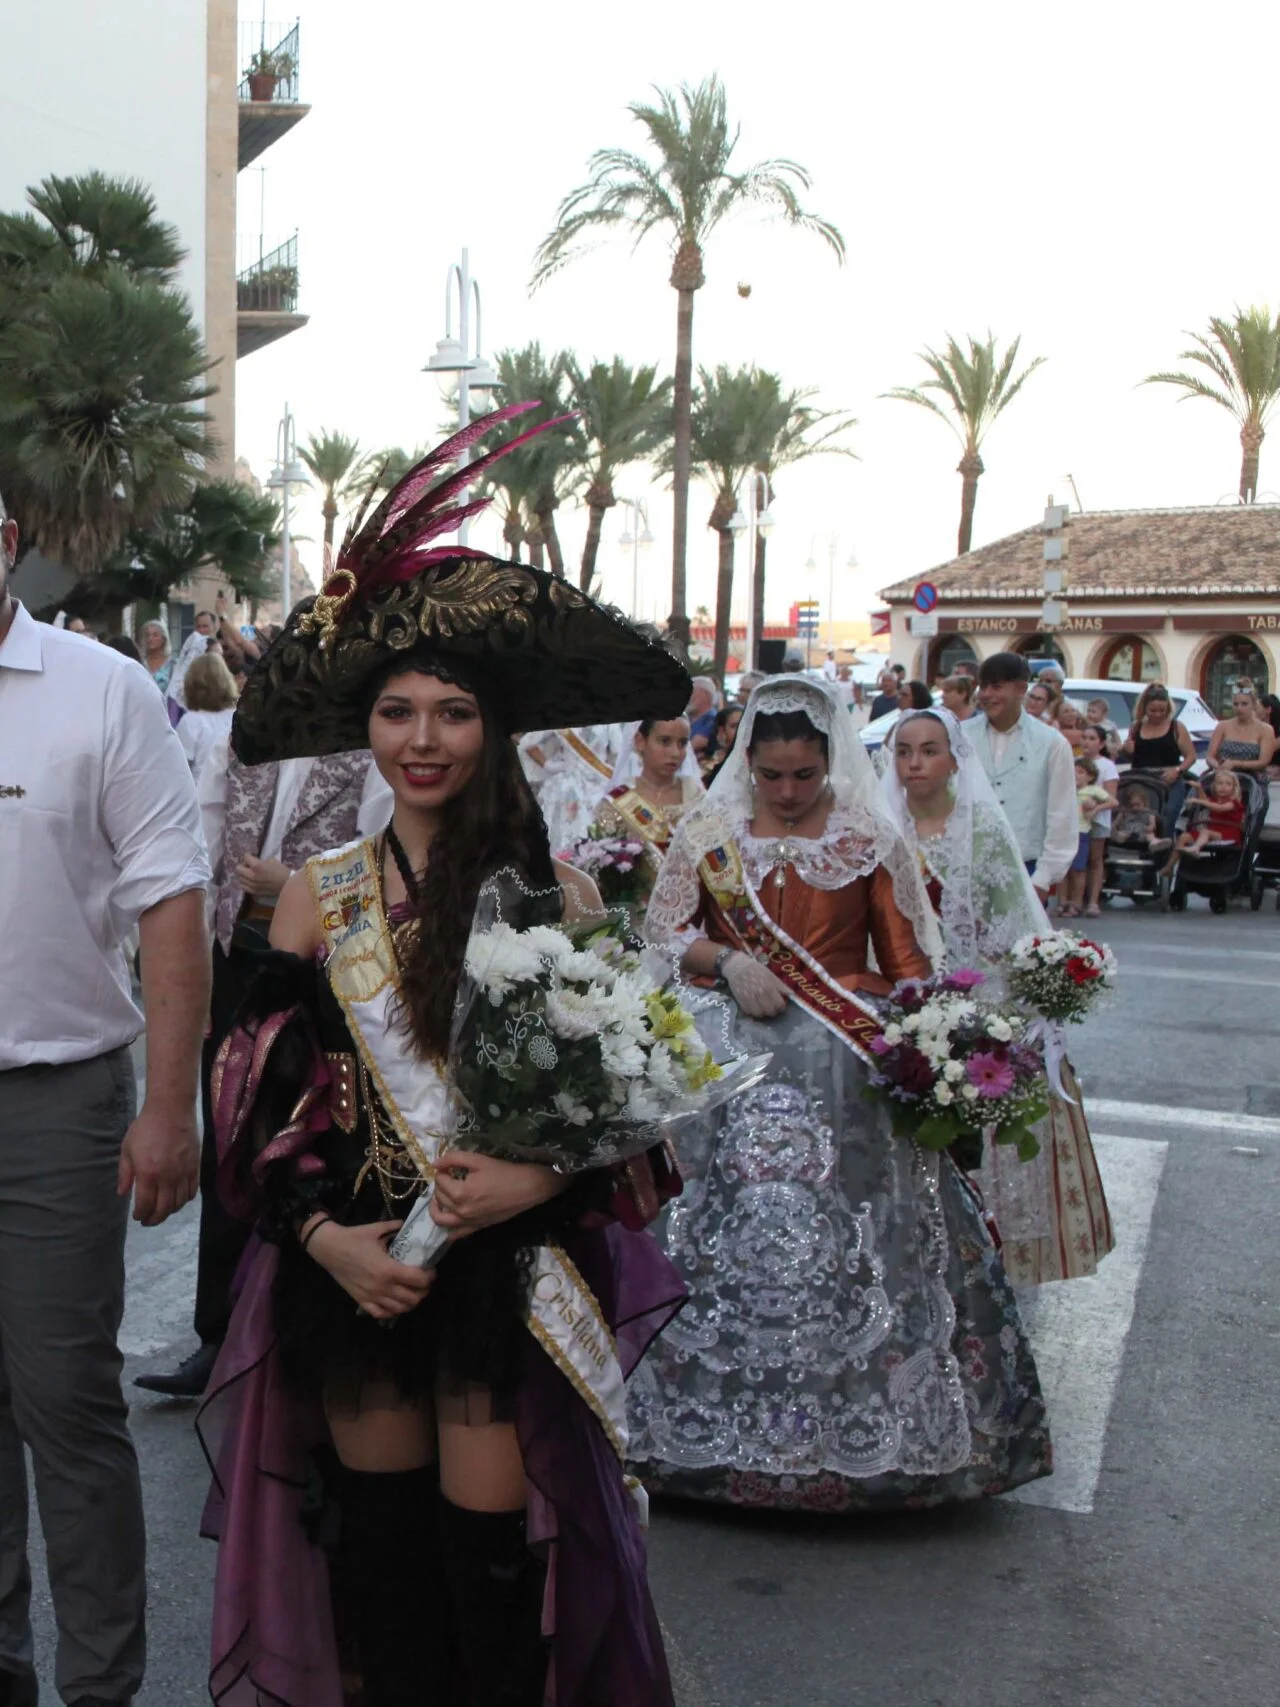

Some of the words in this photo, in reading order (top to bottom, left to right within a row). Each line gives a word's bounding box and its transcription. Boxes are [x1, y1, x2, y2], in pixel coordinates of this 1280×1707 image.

[957, 618, 1017, 631] ESTANCO
[1248, 616, 1280, 629] TAB
[321, 862, 364, 890] 2020
[769, 950, 844, 1013] Comissió
[534, 1272, 607, 1369] Cristiana
